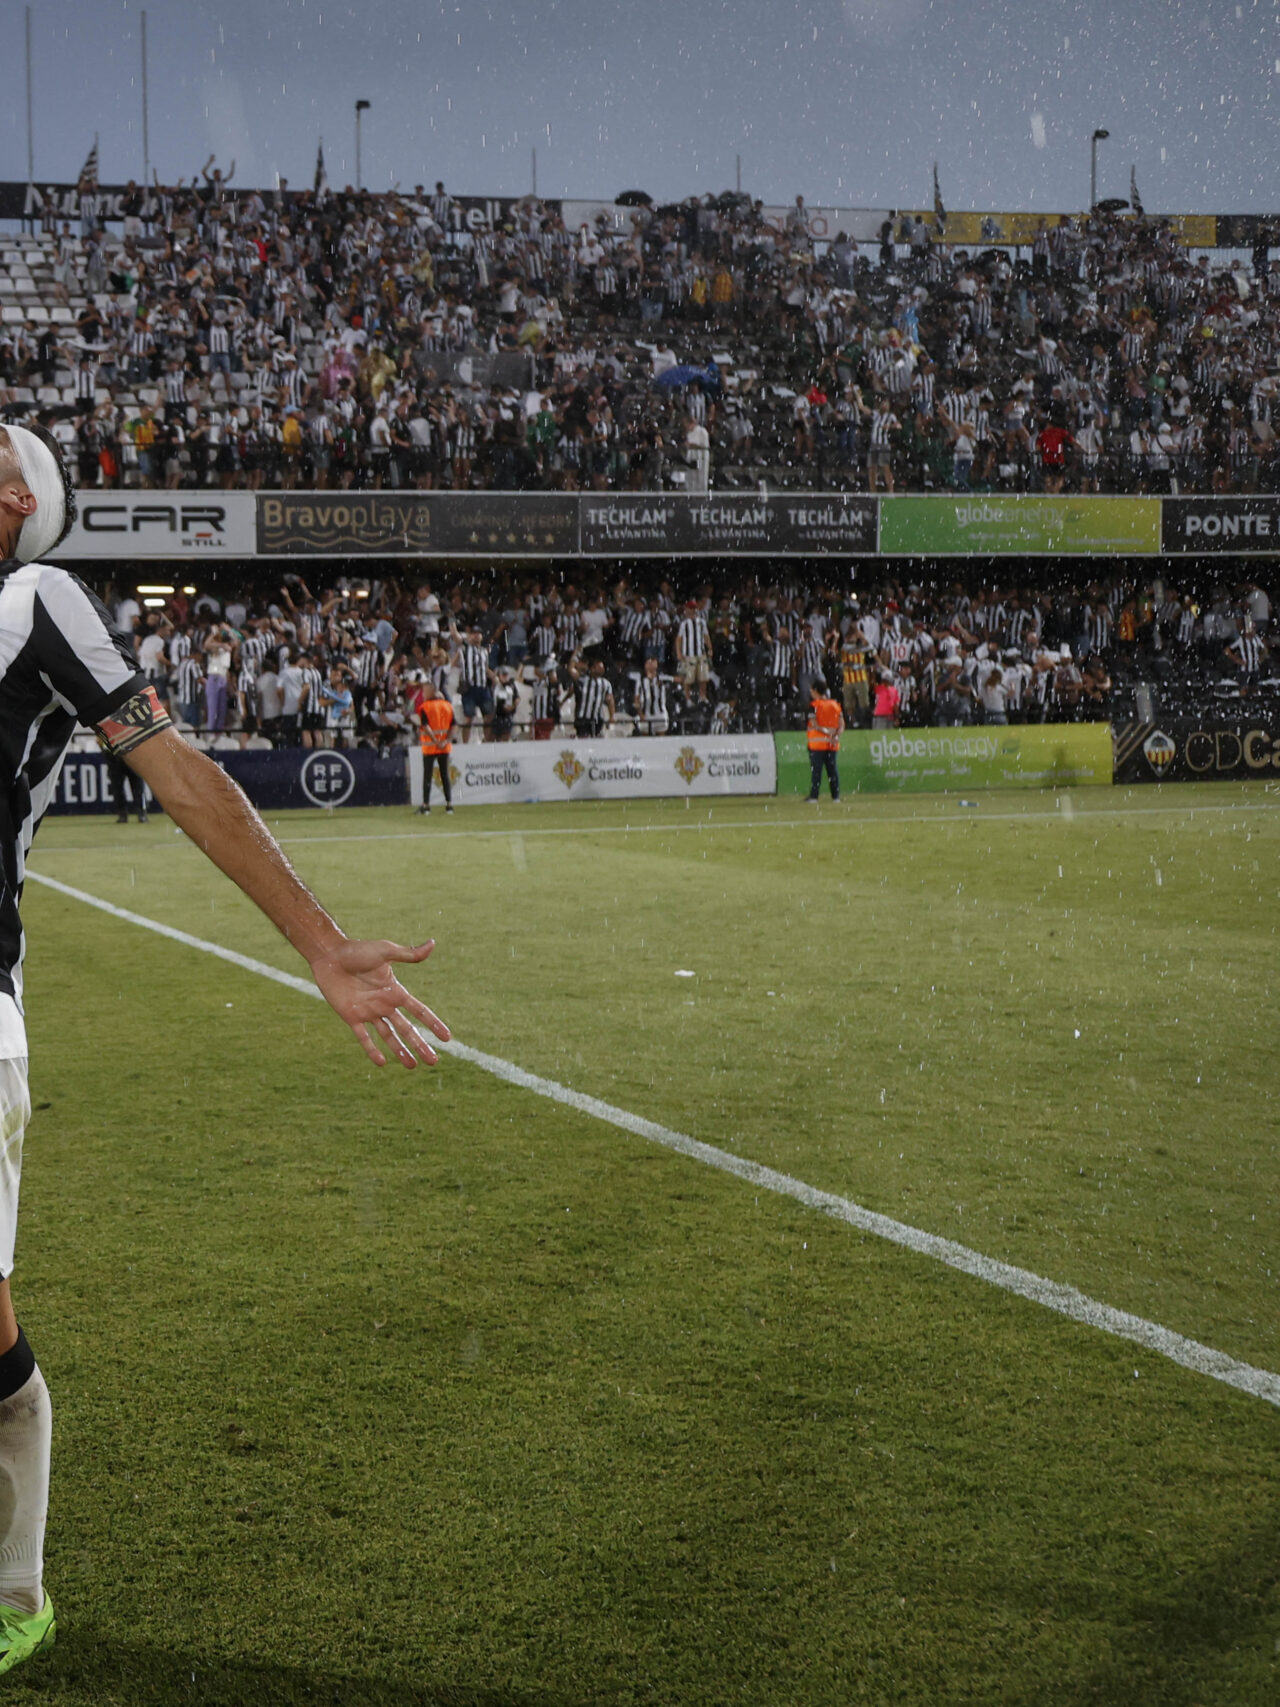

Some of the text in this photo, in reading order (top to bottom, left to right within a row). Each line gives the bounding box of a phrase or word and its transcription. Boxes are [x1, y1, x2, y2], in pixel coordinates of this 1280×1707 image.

[263, 499, 432, 535] Bravoplaya
[1186, 515, 1270, 536] PONTE
[870, 735, 999, 765] globeenergy
